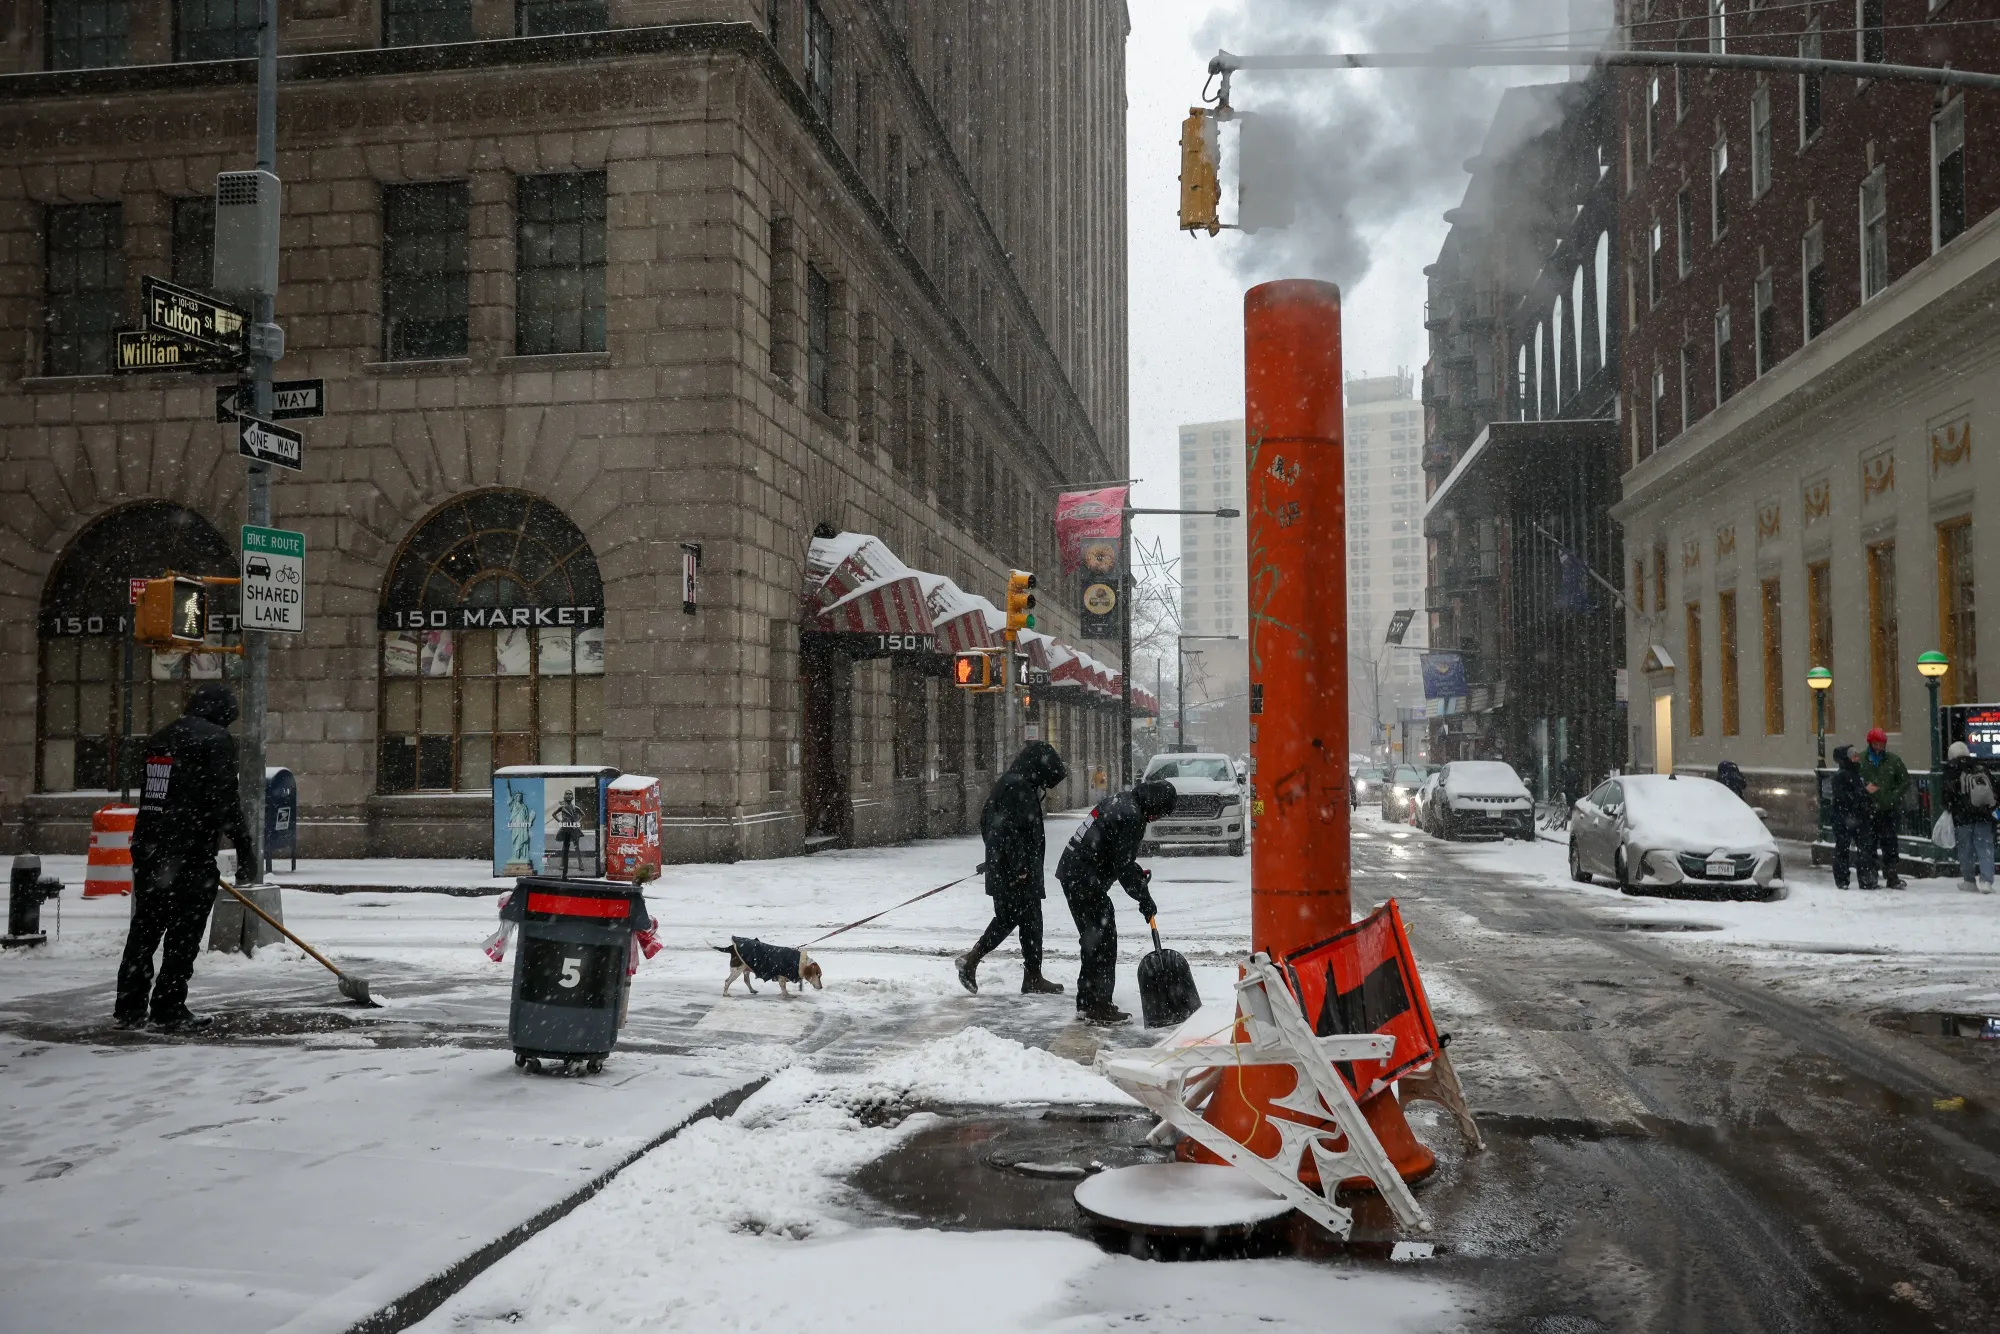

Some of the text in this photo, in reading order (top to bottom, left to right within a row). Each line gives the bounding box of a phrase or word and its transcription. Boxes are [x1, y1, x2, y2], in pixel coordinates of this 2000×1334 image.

[155, 298, 201, 336] Fulton
[204, 315, 213, 329] St
[122, 342, 179, 365] William
[277, 391, 310, 408] WAY
[249, 430, 295, 456] ONE WAY
[247, 533, 300, 552] BIKE ROUTE
[246, 584, 299, 604] SHARED
[255, 605, 289, 623] LANE
[394, 606, 597, 628] 150 MARKET
[54, 616, 104, 634] 150
[878, 635, 916, 650] 150
[147, 764, 171, 778] DOWN
[146, 778, 169, 792] TOWN
[558, 957, 581, 988] 5
